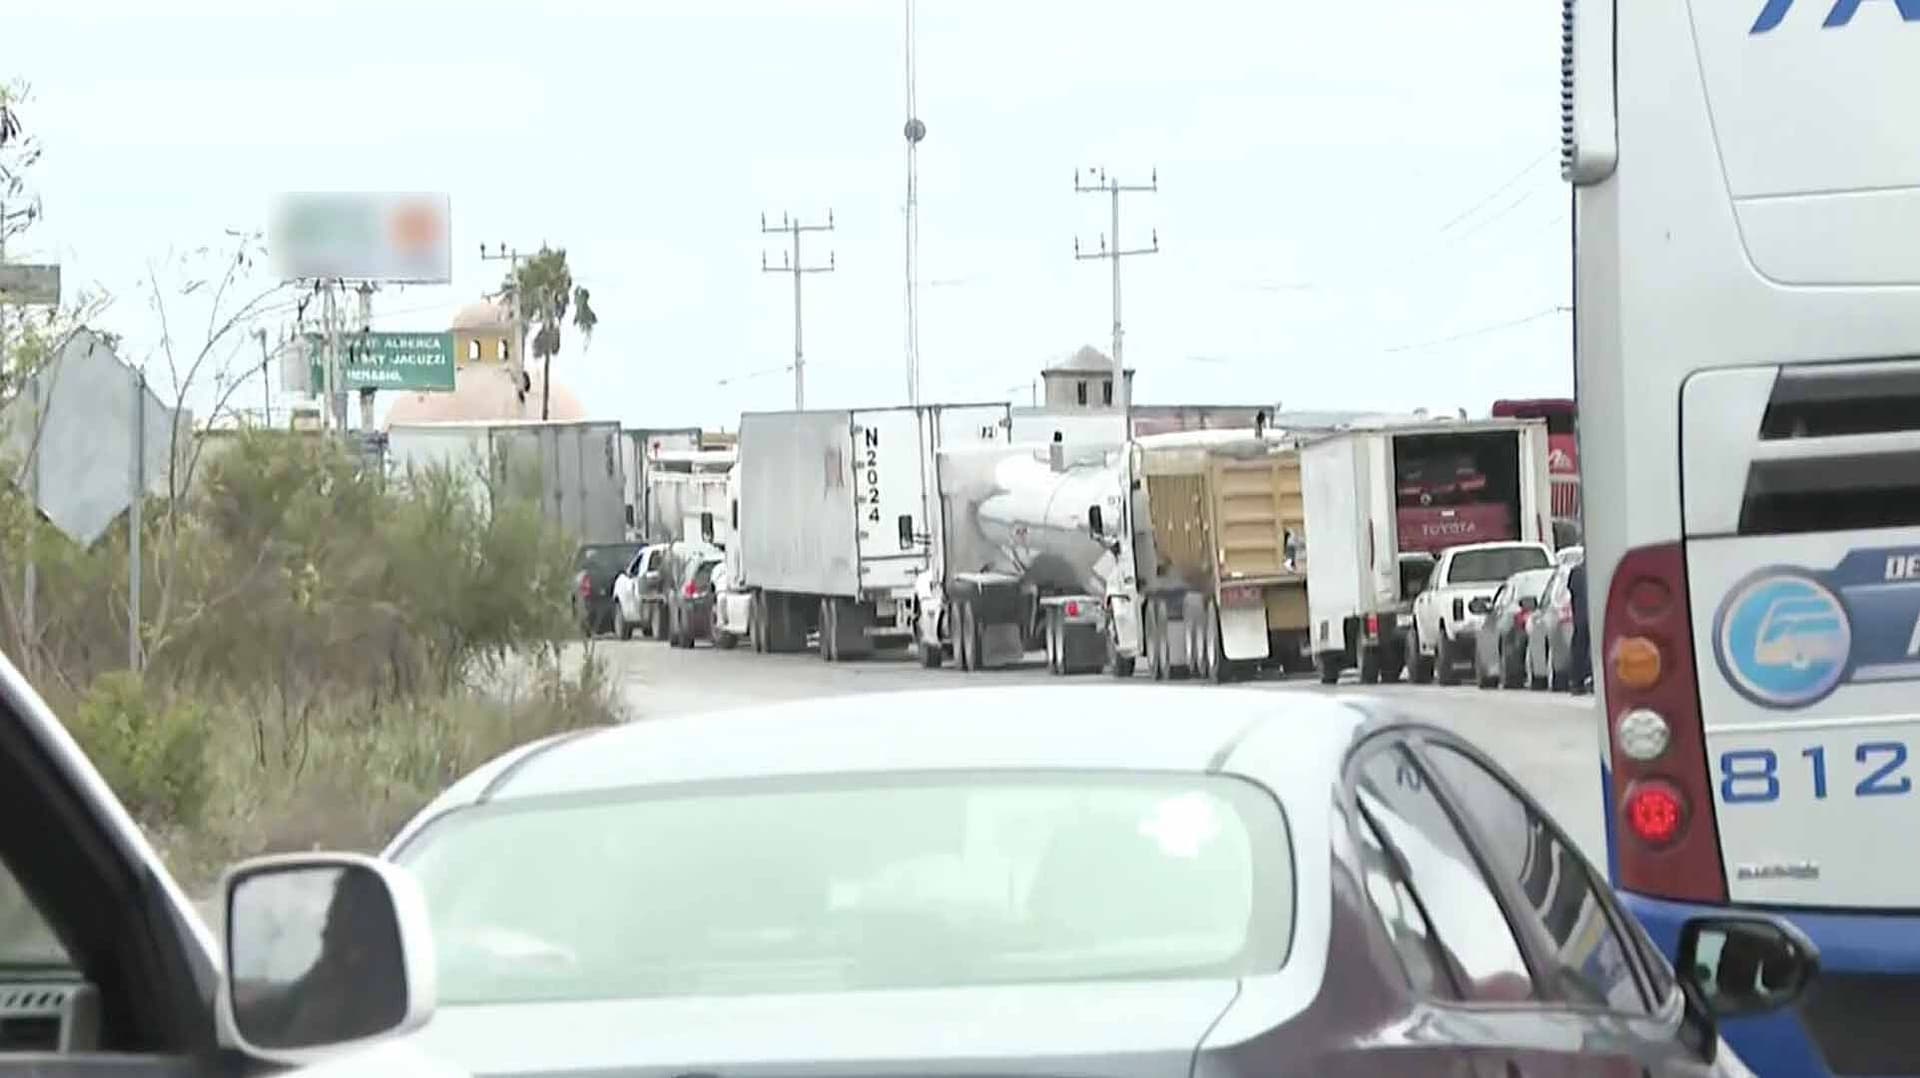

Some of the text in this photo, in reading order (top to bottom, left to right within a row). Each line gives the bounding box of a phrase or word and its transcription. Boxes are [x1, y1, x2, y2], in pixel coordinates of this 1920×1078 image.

[391, 354, 446, 366] JACUZZI
[865, 427, 880, 521] N2024
[1421, 520, 1476, 537] TOYOTA
[1720, 741, 1911, 804] 812
